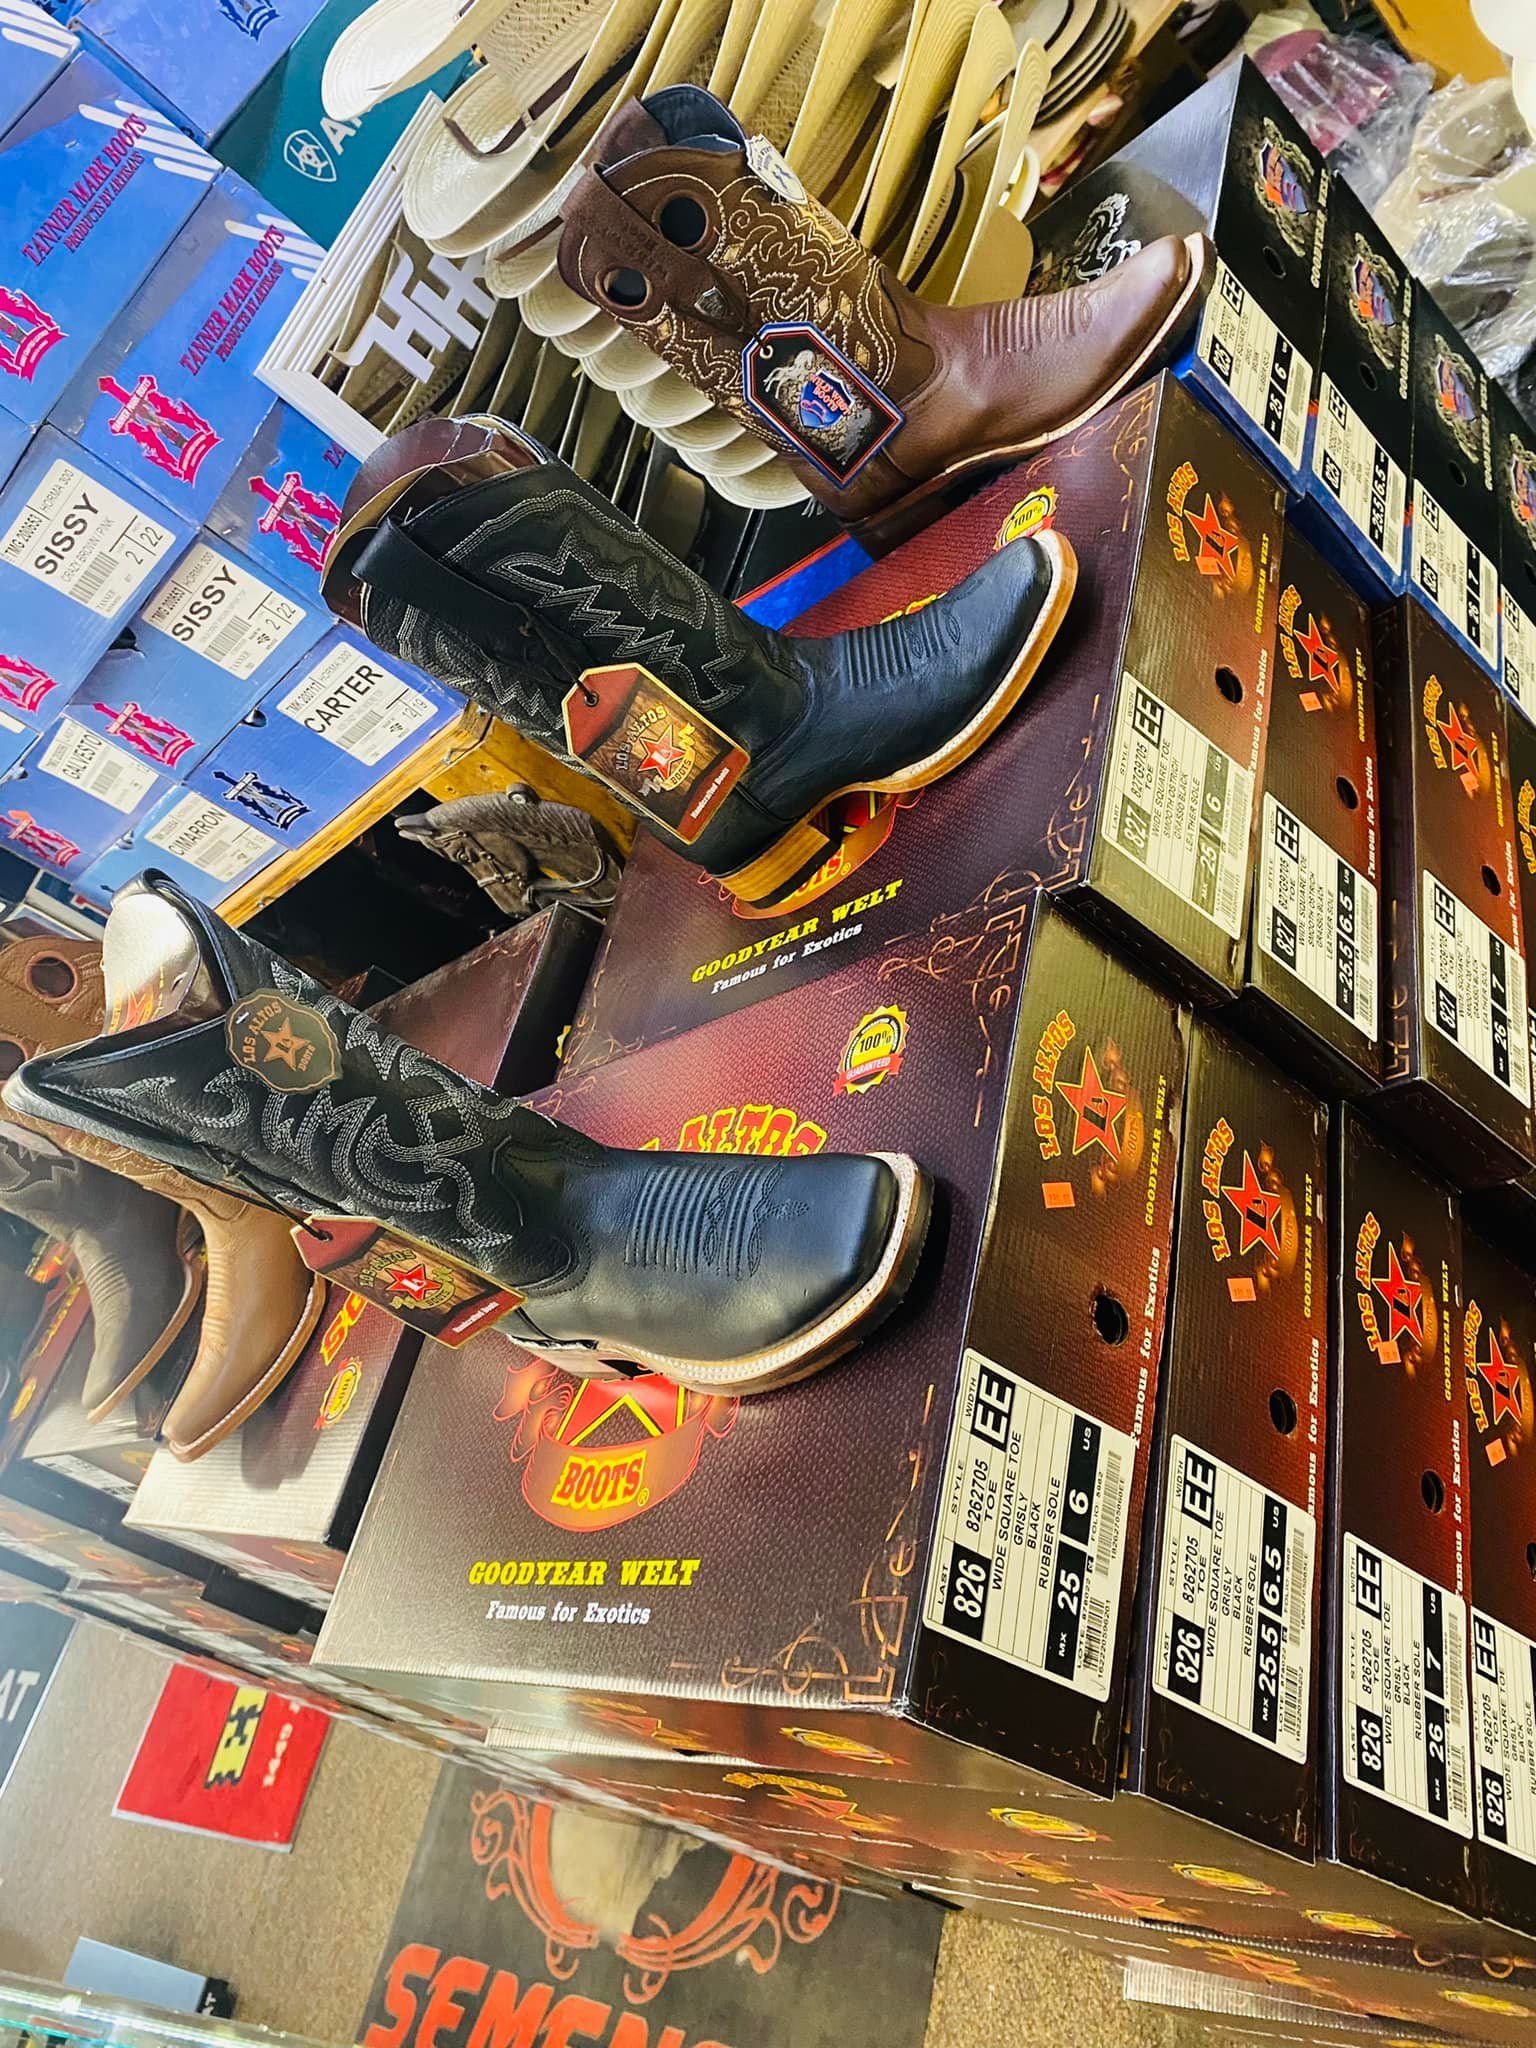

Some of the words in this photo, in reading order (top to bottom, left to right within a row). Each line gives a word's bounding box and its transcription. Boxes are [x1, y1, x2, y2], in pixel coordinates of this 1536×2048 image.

[21, 198, 80, 267] TANNER
[69, 156, 113, 206] MARK
[102, 112, 147, 168] BOOTS
[64, 199, 106, 254] PRODUCTS
[98, 192, 114, 210] BY
[110, 150, 146, 197] ARTISANS
[178, 309, 230, 376] TANNER
[218, 266, 257, 319] MARK
[246, 224, 285, 278] BOOTS
[1221, 272, 1243, 313] EE
[215, 311, 251, 363] PRODUCTS
[246, 293, 260, 318] BY
[1273, 359, 1287, 383] 6
[812, 385, 839, 412] BOOTS
[1268, 390, 1283, 420] 25
[1330, 387, 1346, 428] EE
[1166, 461, 1200, 517] ALTOS
[1373, 462, 1387, 501] 6.5
[5, 537, 25, 557] TMG
[40, 486, 63, 512] HORMA
[34, 493, 99, 575] SISSY
[1012, 506, 1042, 529] 100%
[1422, 490, 1438, 530] EE
[125, 551, 143, 566] 2
[140, 526, 164, 547] 22
[1167, 512, 1191, 562] LOS
[1260, 533, 1270, 564] WELT
[1254, 570, 1267, 635] GOODYEAR
[1468, 568, 1479, 588] 7
[172, 565, 237, 642] SISSY
[265, 619, 281, 631] 2
[277, 602, 296, 620] 22
[1255, 648, 1269, 697] Exotics
[1279, 633, 1303, 679] LOS
[303, 664, 384, 734] CARTER
[402, 707, 418, 721] 12
[1134, 690, 1162, 743] EE
[1253, 701, 1264, 722] for
[615, 742, 632, 771] LOS
[629, 704, 668, 744] ALTOS
[1159, 736, 1170, 763] TOE
[670, 759, 692, 785] BOOTS
[1144, 762, 1154, 792] TOE
[1154, 760, 1168, 809] SQUARE
[1166, 755, 1179, 799] OSTRICH
[1177, 769, 1188, 803] BLACK
[1189, 774, 1200, 806] SOLE
[1122, 803, 1148, 851] 827
[1151, 806, 1162, 839] WIDE
[1162, 795, 1174, 840] SMOOTH
[1172, 799, 1185, 841] GRASSO
[1204, 789, 1222, 816] 6
[167, 807, 228, 857] CIMARRON
[1184, 803, 1197, 854] LEATHER
[1276, 809, 1297, 859] EE
[1198, 839, 1217, 876] 25
[691, 917, 819, 983] GOODYEAR
[831, 879, 904, 924] WELT
[1338, 888, 1352, 937] 6.5
[1435, 887, 1454, 934] EE
[711, 963, 767, 995] Famous
[772, 951, 797, 970] for
[801, 922, 864, 958] Exotics
[1276, 915, 1294, 959] 827
[1338, 938, 1352, 991] 25.5
[1491, 971, 1504, 996] 7
[248, 1000, 282, 1035] ALTOS
[1439, 988, 1455, 1030] 827
[242, 1036, 257, 1063] LOS
[298, 1044, 316, 1072] BOOTS
[859, 1030, 892, 1053] 100%
[1032, 1009, 1076, 1094] ALTOS
[1493, 1018, 1507, 1051] 26
[1032, 1094, 1061, 1161] LOS
[1144, 1128, 1162, 1226] GOODYEAR
[1156, 1074, 1167, 1120] WELT
[1201, 1116, 1235, 1199] ALTOS
[1305, 1173, 1314, 1218] WELT
[1203, 1200, 1231, 1262] LOS
[1355, 1211, 1381, 1290] ALTOS
[359, 1266, 377, 1288] LOS
[369, 1247, 417, 1269] ALTOS
[1144, 1247, 1160, 1320] Exotics
[1303, 1225, 1313, 1318] GOODYEAR
[1139, 1327, 1153, 1360] for
[1357, 1293, 1382, 1352] LOS
[1308, 1337, 1320, 1406] Exotics
[1442, 1310, 1452, 1401] GOODYEAR
[972, 1372, 1012, 1444] EE
[1307, 1415, 1318, 1444] for
[1466, 1377, 1489, 1433] LOS
[1006, 1428, 1022, 1467] TOE
[1067, 1486, 1090, 1518] 6
[1081, 1425, 1092, 1452] US
[1453, 1419, 1461, 1486] Exotics
[551, 1449, 648, 1510] BOOTS
[964, 1456, 989, 1533] 8262705
[983, 1478, 998, 1524] TOE
[996, 1466, 1018, 1542] SQUARE
[1045, 1475, 1061, 1520] SOLE
[1183, 1455, 1214, 1523] EE
[1011, 1491, 1030, 1547] GRISLY
[1026, 1500, 1042, 1550] BLACK
[1213, 1507, 1224, 1542] TOE
[1453, 1494, 1463, 1523] for
[468, 1557, 608, 1587] GOODYEAR
[619, 1557, 701, 1587] WELT
[990, 1543, 1007, 1592] WIDE
[1037, 1521, 1056, 1590] RUBBER
[1181, 1533, 1199, 1605] 8262705
[1196, 1553, 1207, 1596] TOE
[1208, 1542, 1222, 1613] SQUARE
[1246, 1550, 1257, 1593] SOLE
[1261, 1542, 1282, 1609] 6.5
[950, 1556, 988, 1620] 826
[1055, 1565, 1081, 1616] 25
[1220, 1564, 1233, 1618] GRISLY
[1232, 1573, 1243, 1620] BLACK
[1358, 1551, 1380, 1614] EE
[485, 1600, 546, 1624] Famous
[551, 1602, 577, 1623] for
[585, 1602, 652, 1626] Exotics
[1205, 1614, 1217, 1660] WIDE
[1243, 1593, 1255, 1658] RUBBER
[1174, 1625, 1201, 1686] 826
[1257, 1621, 1279, 1698] 25.5
[1361, 1627, 1372, 1695] 8262705
[1383, 1634, 1391, 1701] SQUARE
[1426, 1646, 1441, 1674] 7
[1475, 1621, 1497, 1678] EE
[1393, 1654, 1401, 1704] GRISLY
[1402, 1662, 1410, 1706] BLACK
[1384, 1702, 1392, 1746] WIDE
[1413, 1679, 1422, 1741] RUBBER
[1361, 1716, 1381, 1772] 826
[1428, 1719, 1444, 1763] 26
[1486, 1778, 1504, 1826] 826
